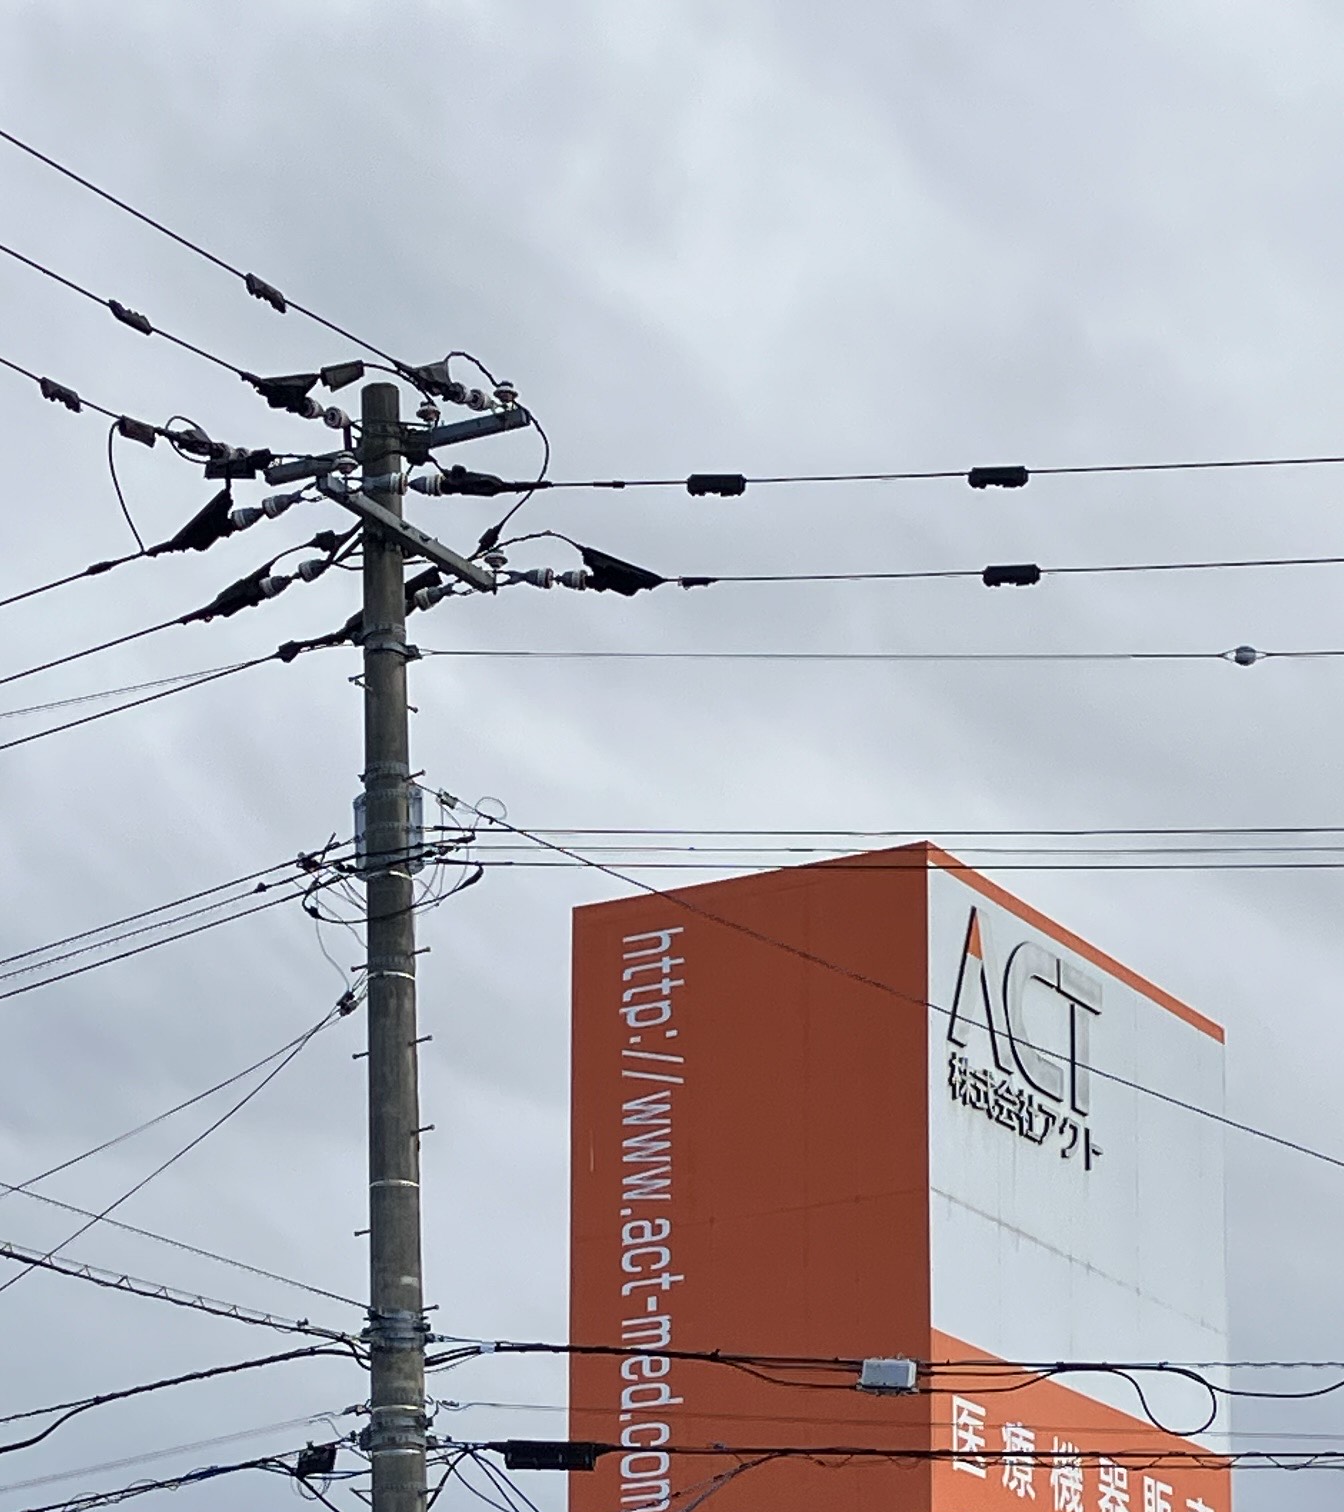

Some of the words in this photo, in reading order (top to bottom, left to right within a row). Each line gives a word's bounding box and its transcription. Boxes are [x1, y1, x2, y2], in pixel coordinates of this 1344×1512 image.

[947, 905, 1102, 1117] ACT
[948, 1051, 1104, 1171] 株式会社アクト
